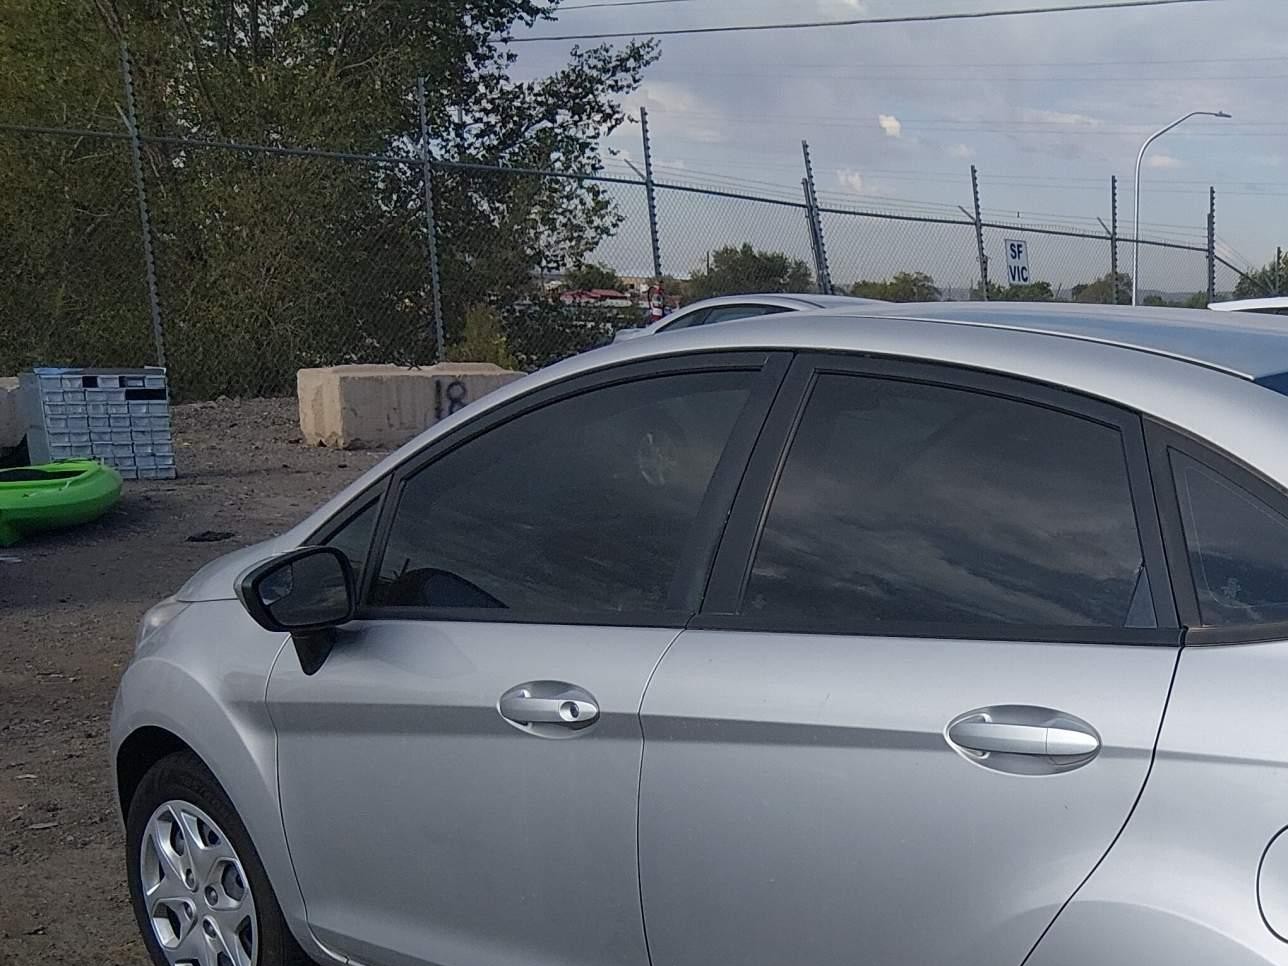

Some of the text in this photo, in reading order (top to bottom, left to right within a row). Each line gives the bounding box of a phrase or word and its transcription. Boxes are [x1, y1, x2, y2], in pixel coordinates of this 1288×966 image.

[1009, 242, 1023, 260] SF
[1009, 264, 1029, 282] VIC
[434, 379, 468, 419] 18
